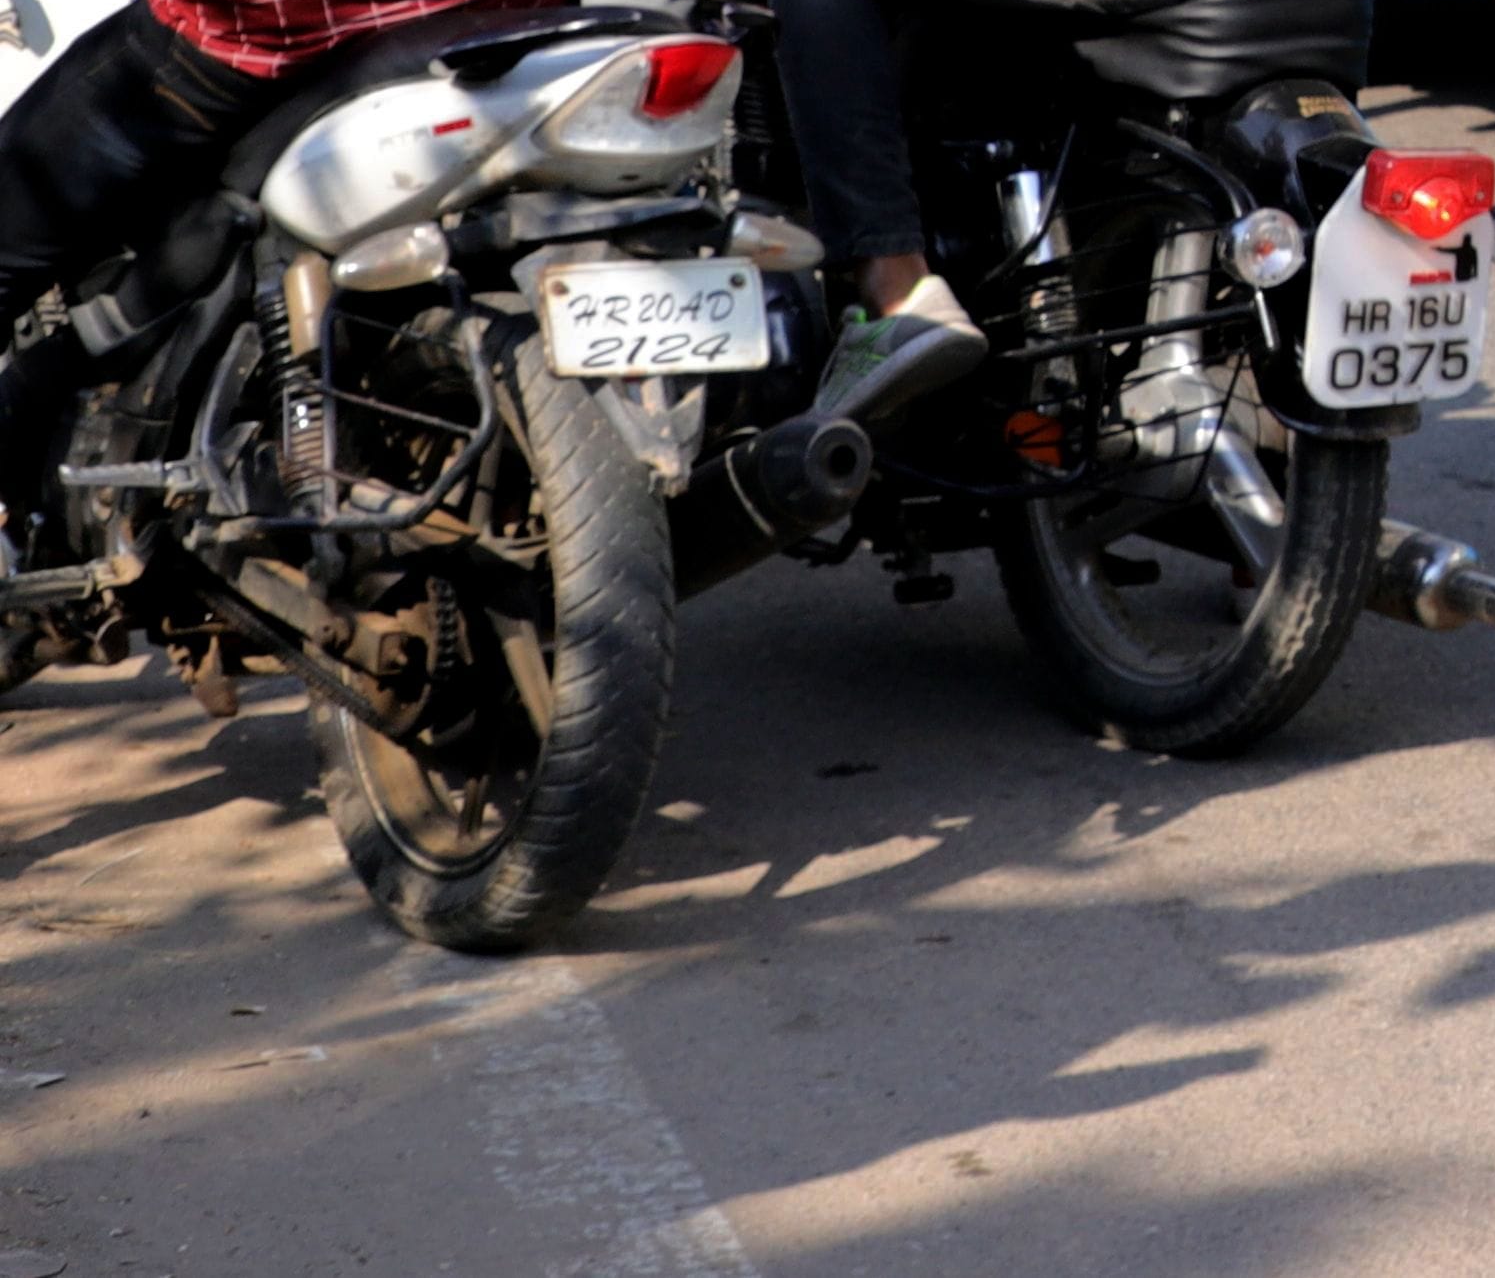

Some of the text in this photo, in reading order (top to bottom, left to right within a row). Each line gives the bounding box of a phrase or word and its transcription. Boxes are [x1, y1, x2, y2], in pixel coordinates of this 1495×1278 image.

[1341, 293, 1466, 334] HR 16U
[581, 332, 732, 368] 2124
[1328, 339, 1470, 391] 0375
